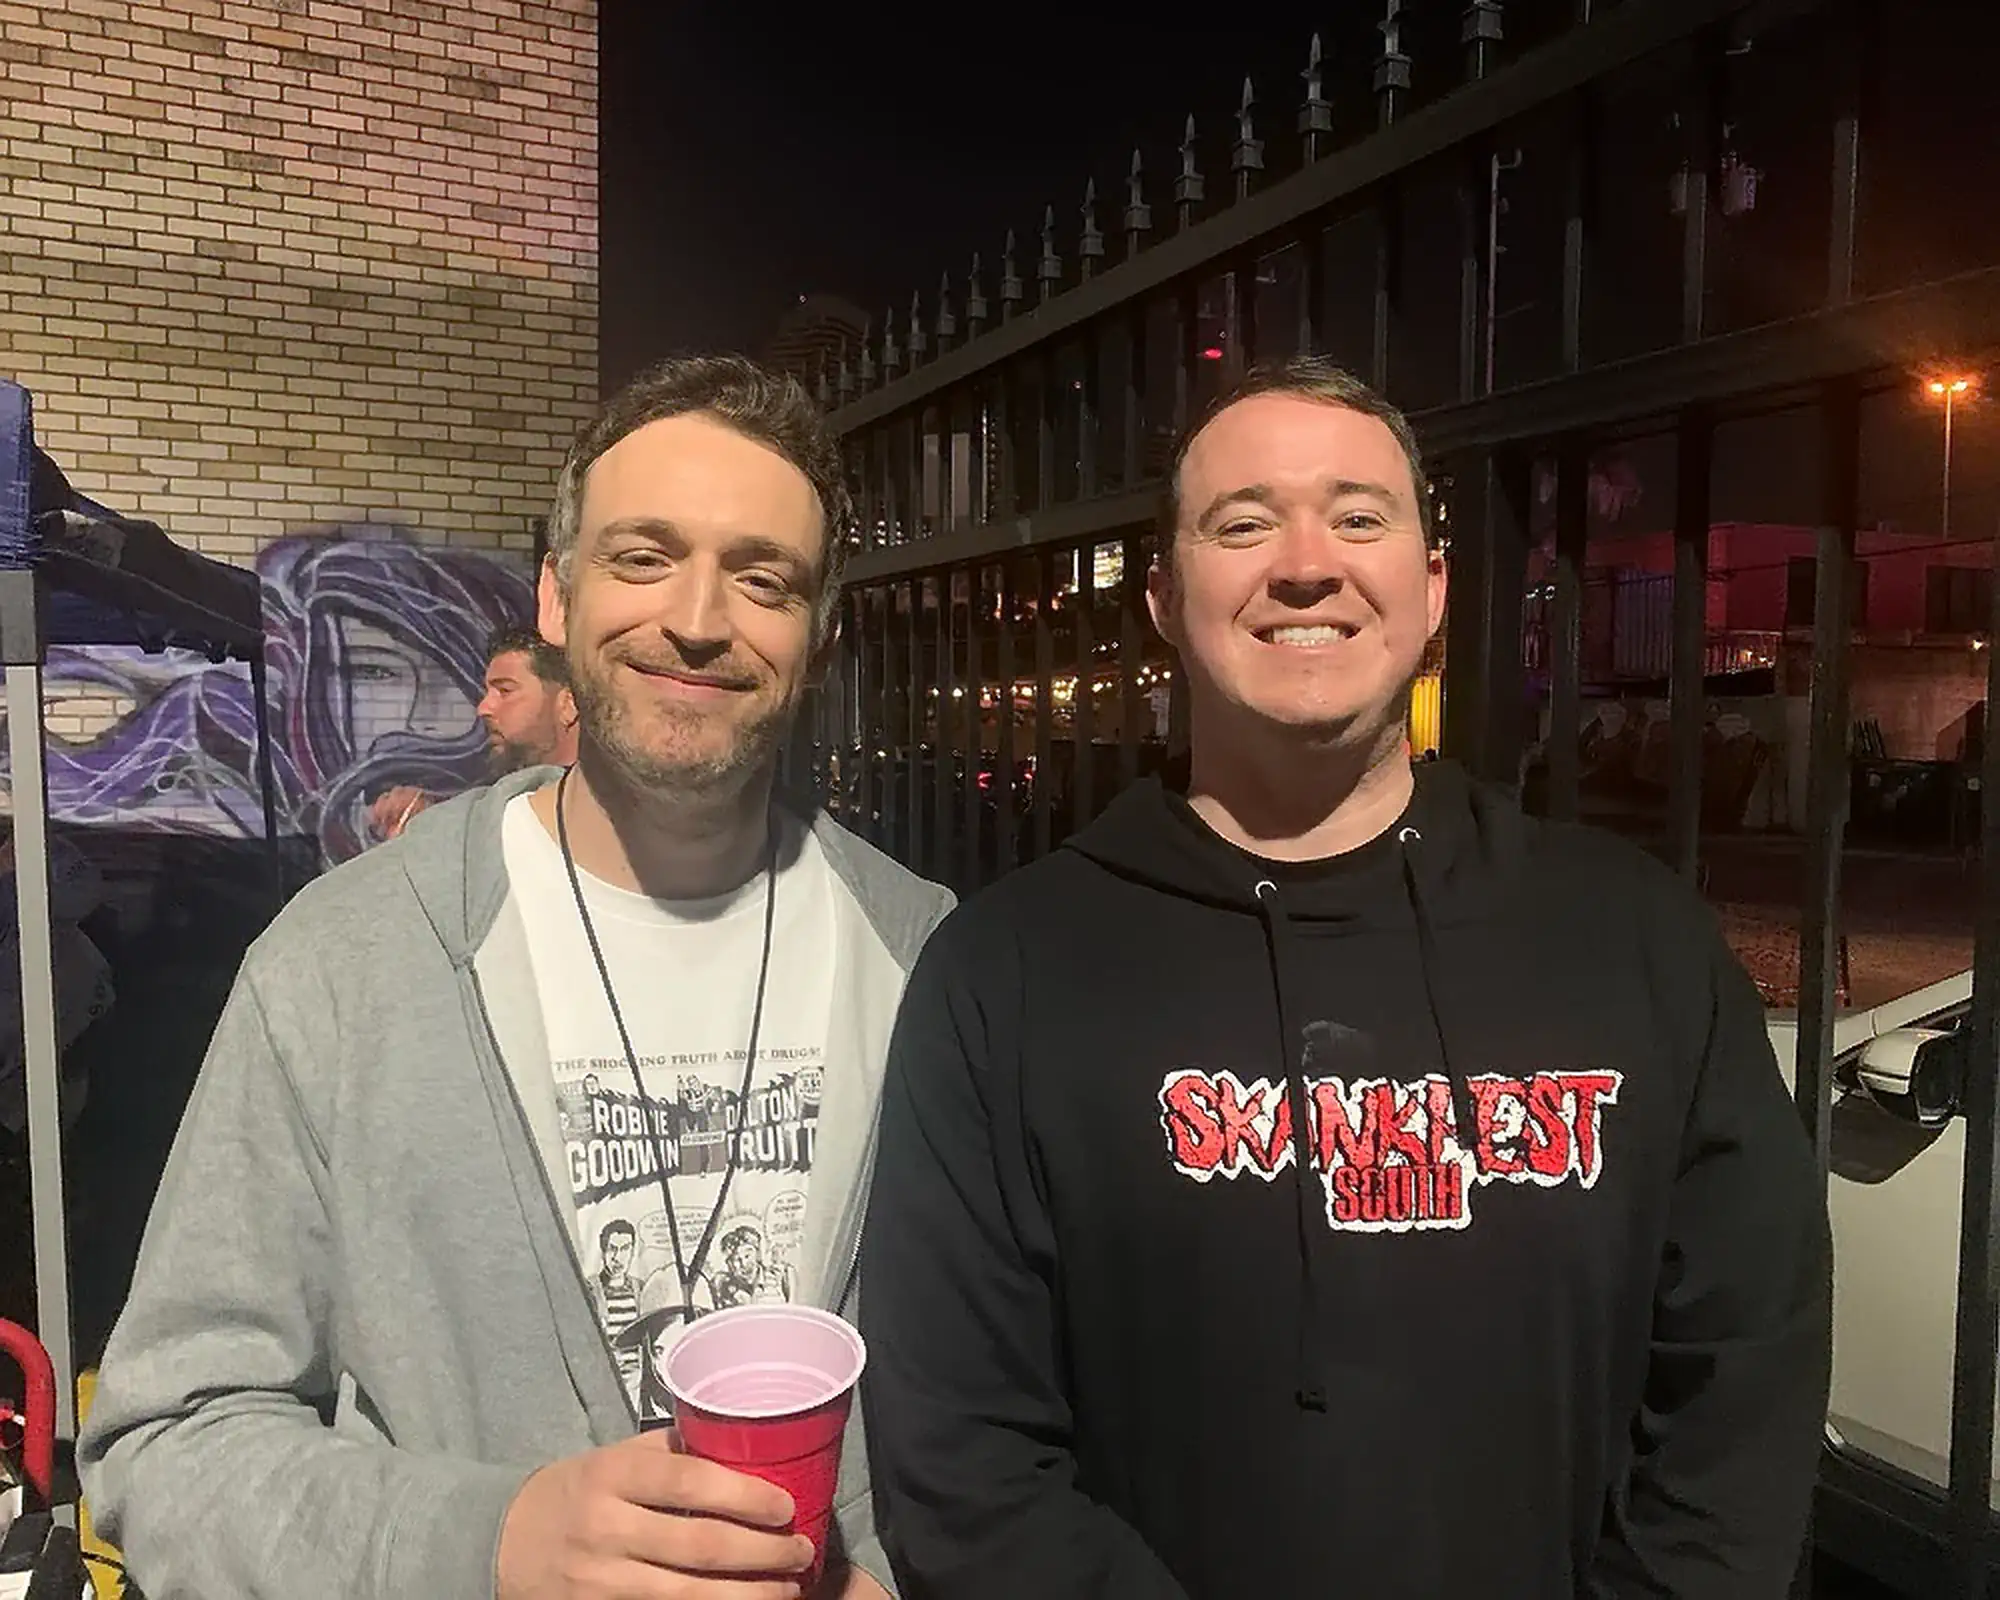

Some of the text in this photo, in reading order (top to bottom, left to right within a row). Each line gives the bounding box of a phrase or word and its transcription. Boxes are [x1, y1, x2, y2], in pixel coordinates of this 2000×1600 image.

[556, 1057, 586, 1071] THE
[589, 1055, 666, 1070] SHOCING
[671, 1052, 718, 1065] TRUTH
[723, 1049, 767, 1061] ABOT
[593, 1098, 669, 1136] ROBIE
[1331, 1161, 1463, 1223] SOUTH
